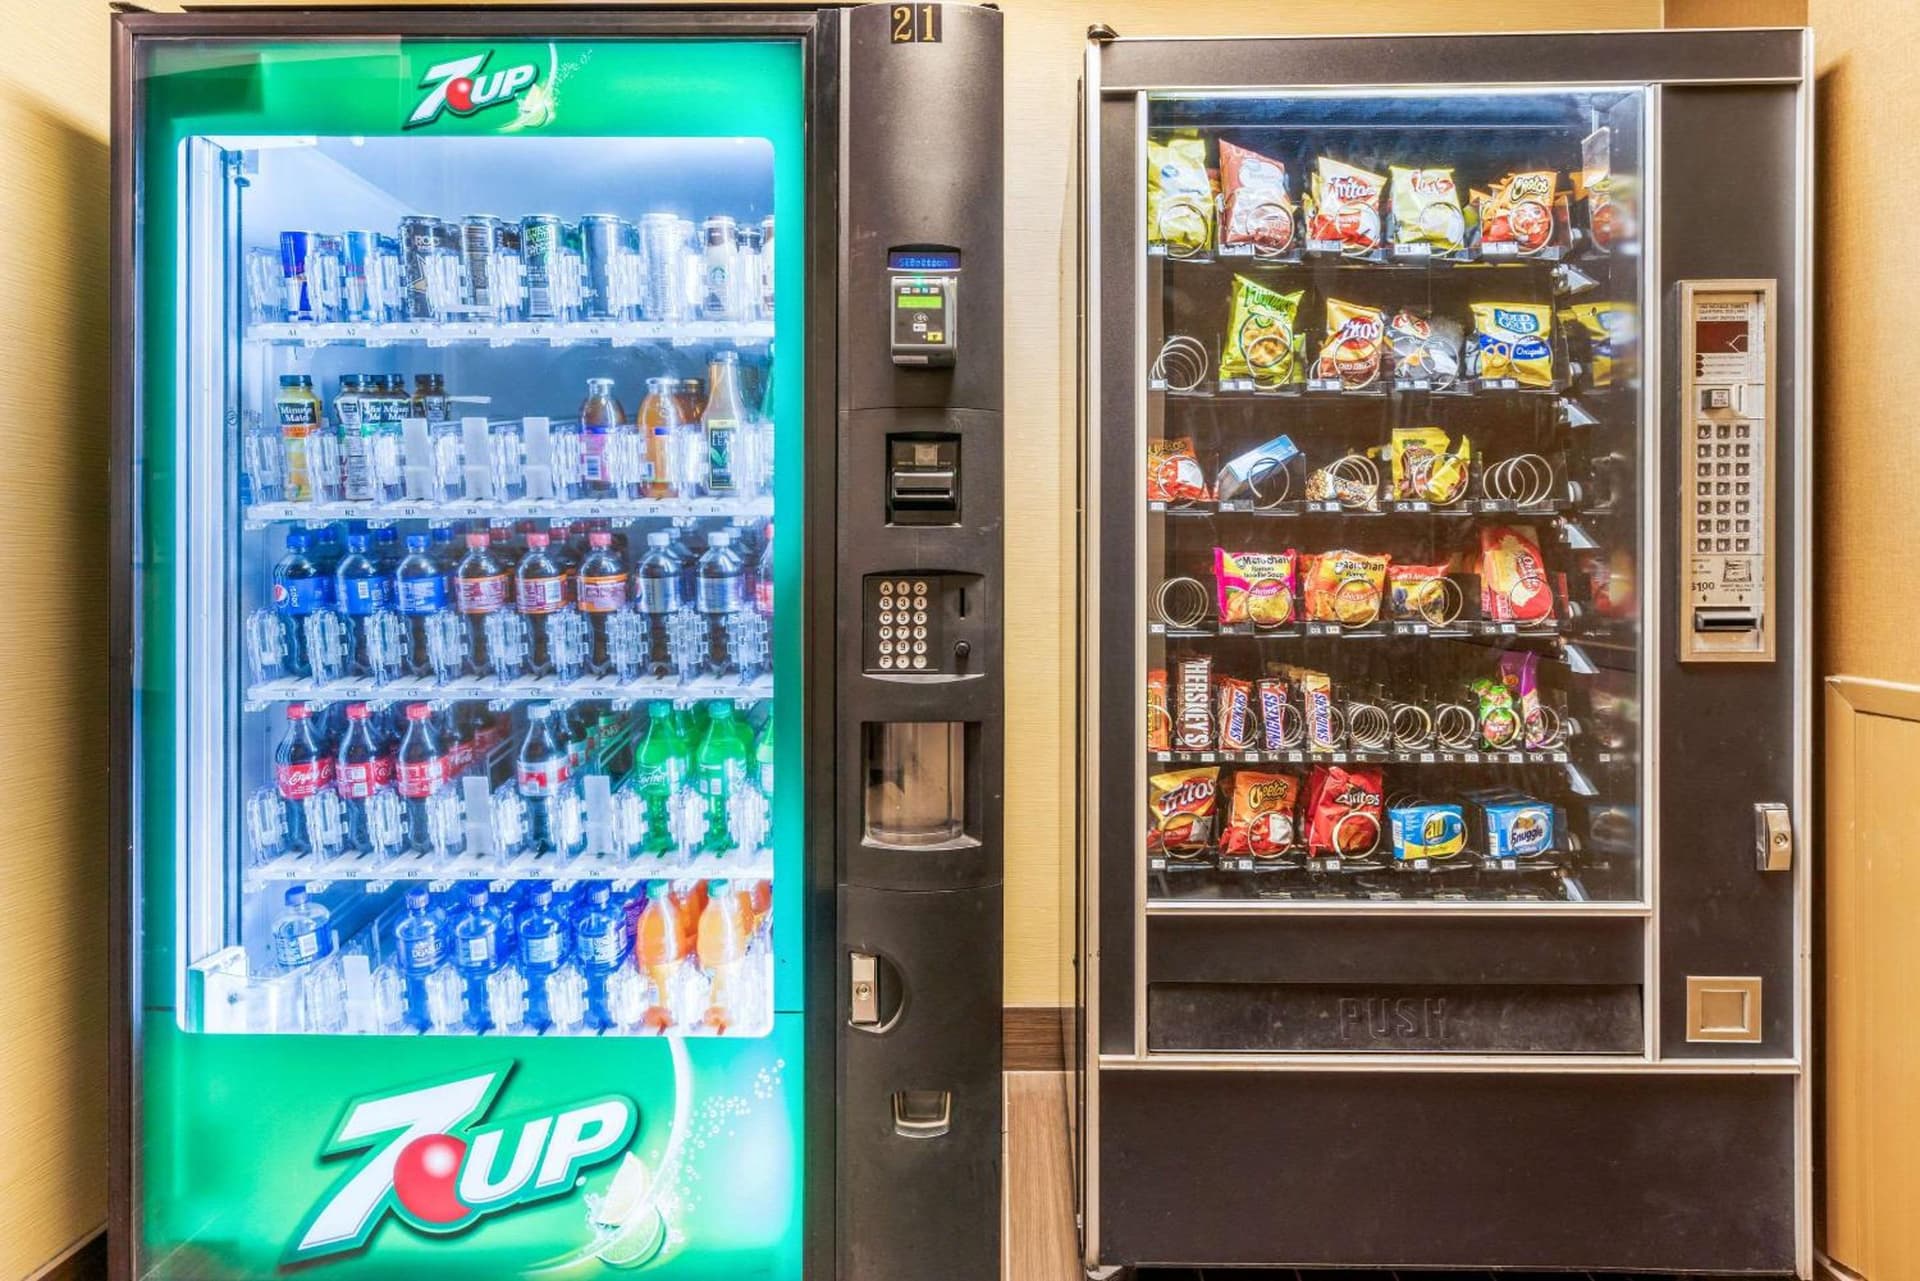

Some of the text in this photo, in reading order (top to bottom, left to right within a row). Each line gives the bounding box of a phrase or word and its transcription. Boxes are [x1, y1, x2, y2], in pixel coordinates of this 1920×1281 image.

[893, 6, 935, 41] 21
[408, 53, 534, 126] 7UP
[1229, 690, 1248, 742] SNICKERS
[1263, 692, 1281, 750] SNICKERS
[1314, 692, 1330, 742] SNICKERS
[1160, 778, 1217, 817] Fritos
[1249, 780, 1288, 809] Cheetos
[1335, 790, 1380, 808] Doritos
[1425, 818, 1444, 839] all
[1511, 825, 1544, 845] Snuggle
[1339, 998, 1449, 1039] PUSH
[296, 1071, 631, 1251] 7UP
